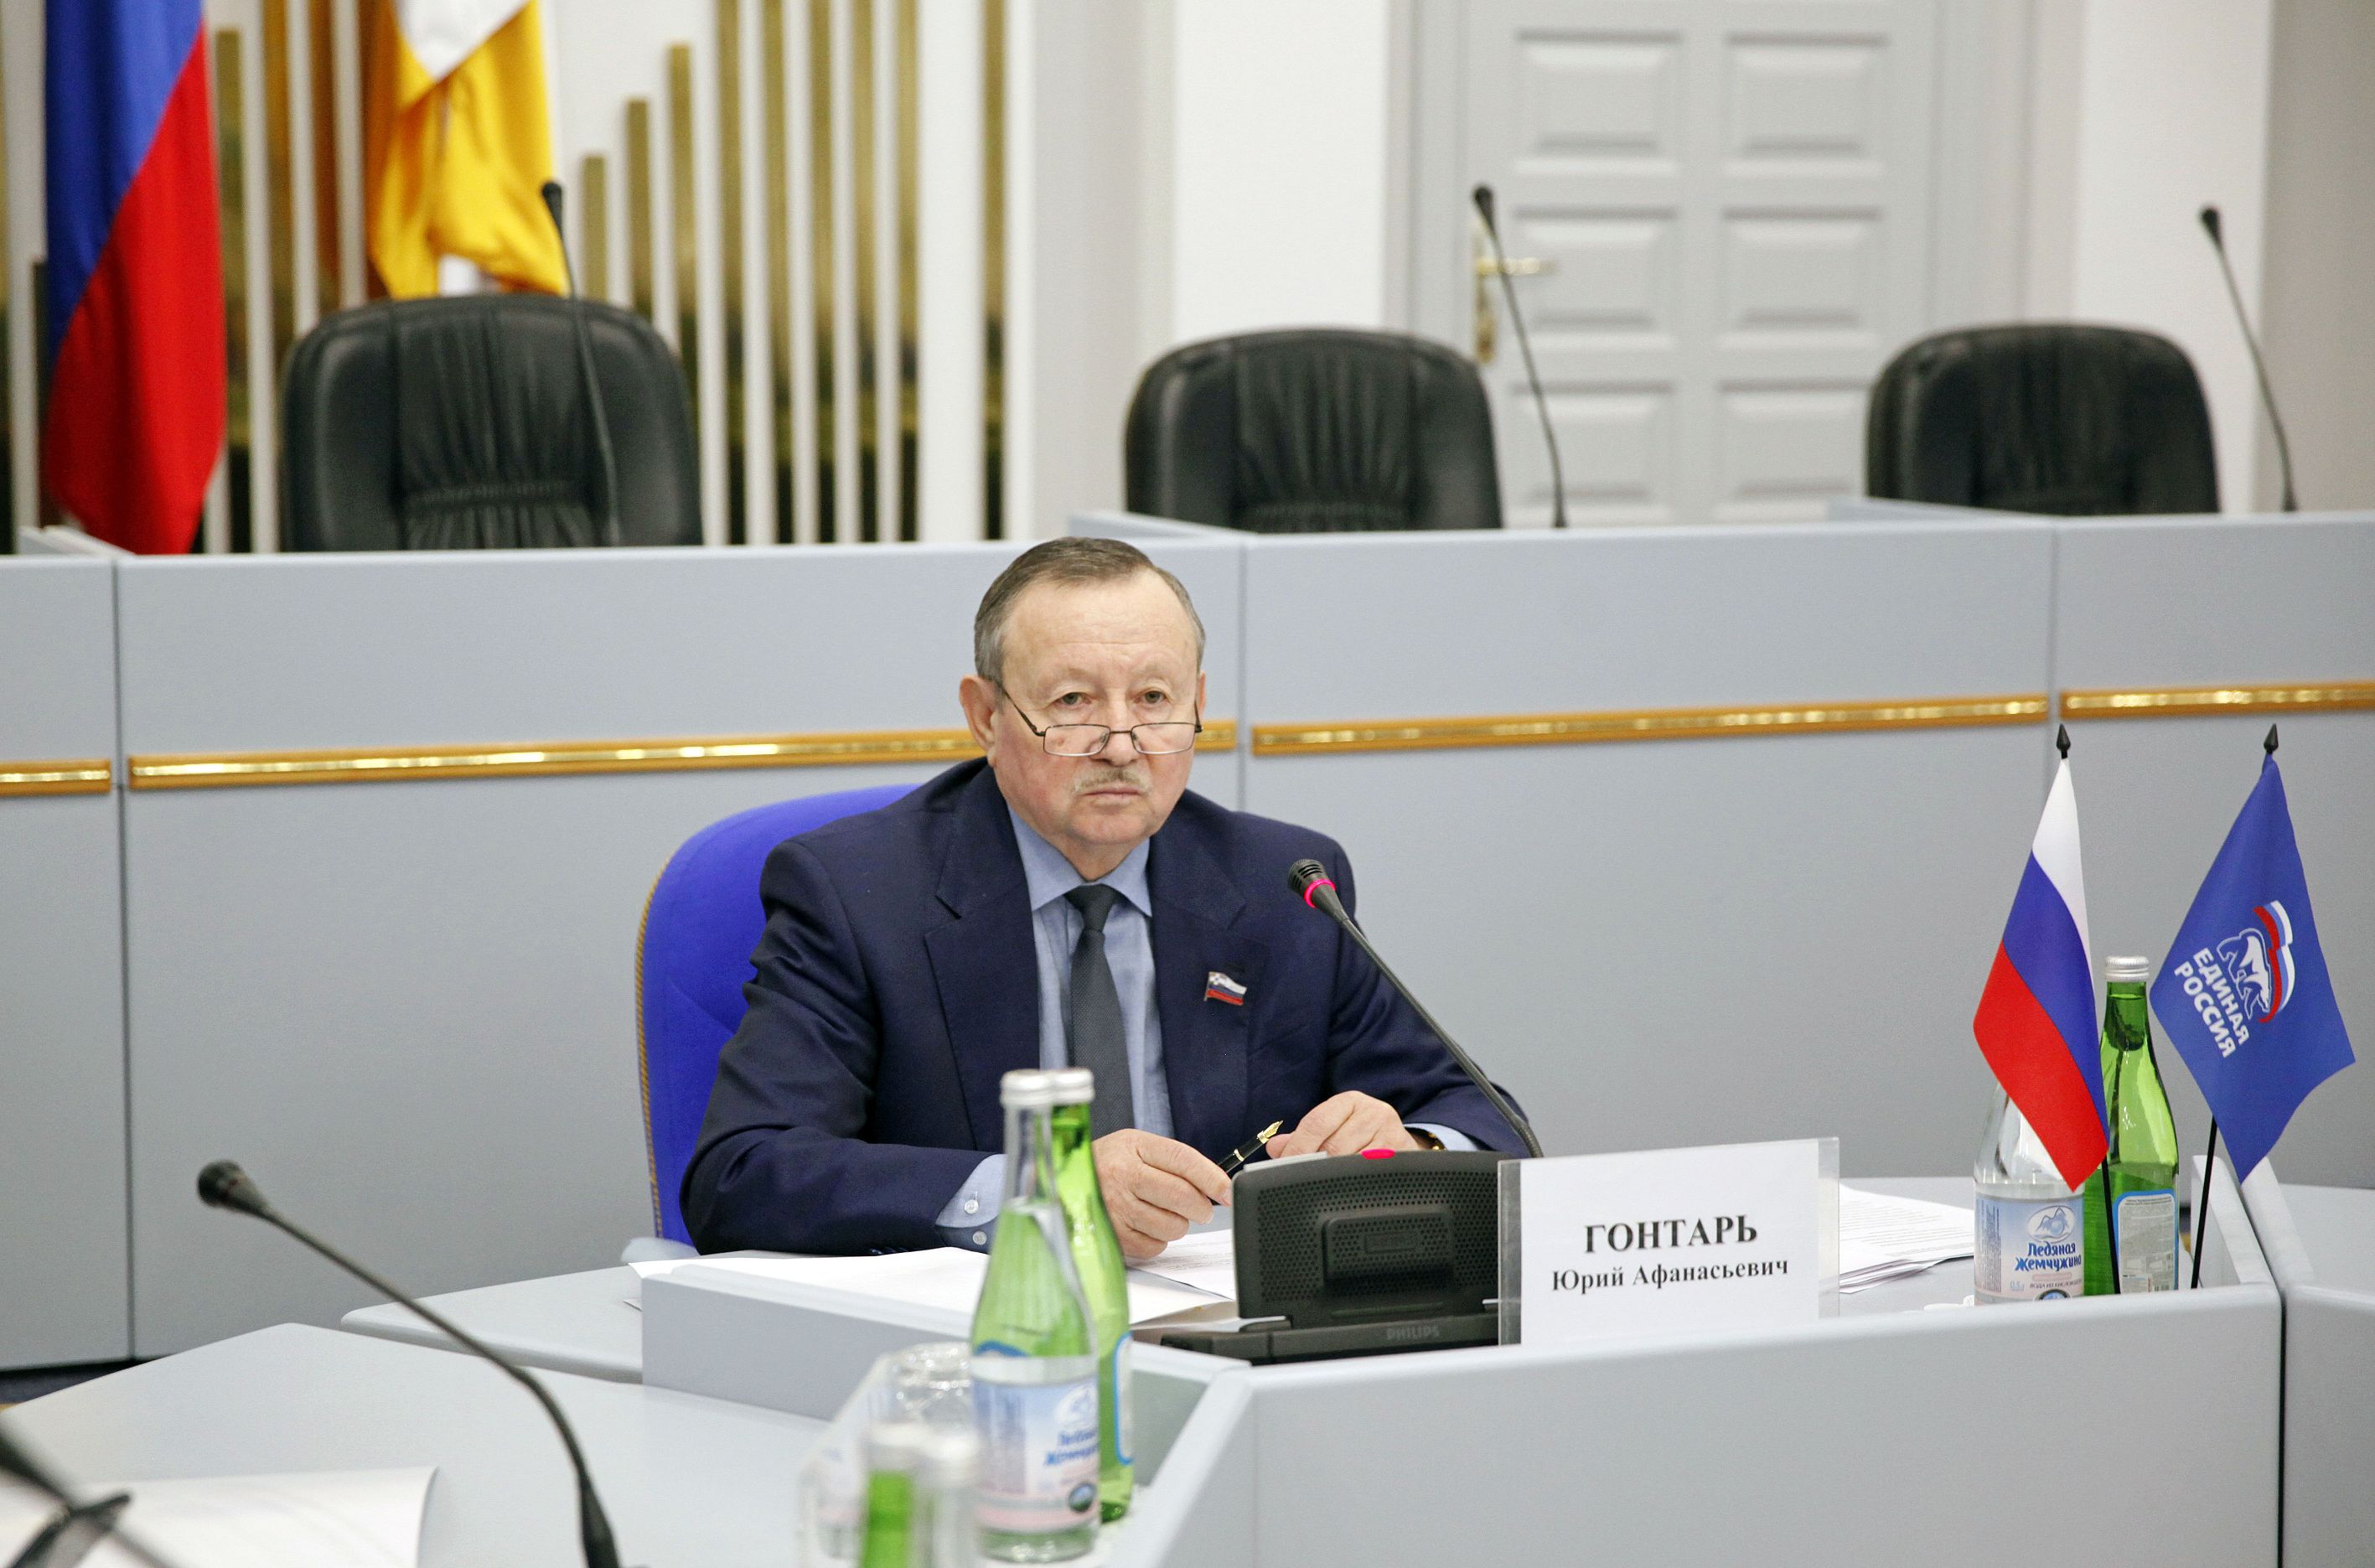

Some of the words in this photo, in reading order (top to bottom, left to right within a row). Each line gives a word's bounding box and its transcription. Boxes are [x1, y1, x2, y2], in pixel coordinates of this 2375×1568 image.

[2174, 961, 2236, 1058] РОССИЯ
[2193, 948, 2250, 1045] ЕДИНАЯ
[1585, 1214, 1757, 1253] ГОНТАРЬ
[2028, 1241, 2076, 1257] Ледяная
[1552, 1267, 1624, 1295] Юрий
[1632, 1260, 1788, 1289] Афанасьевич
